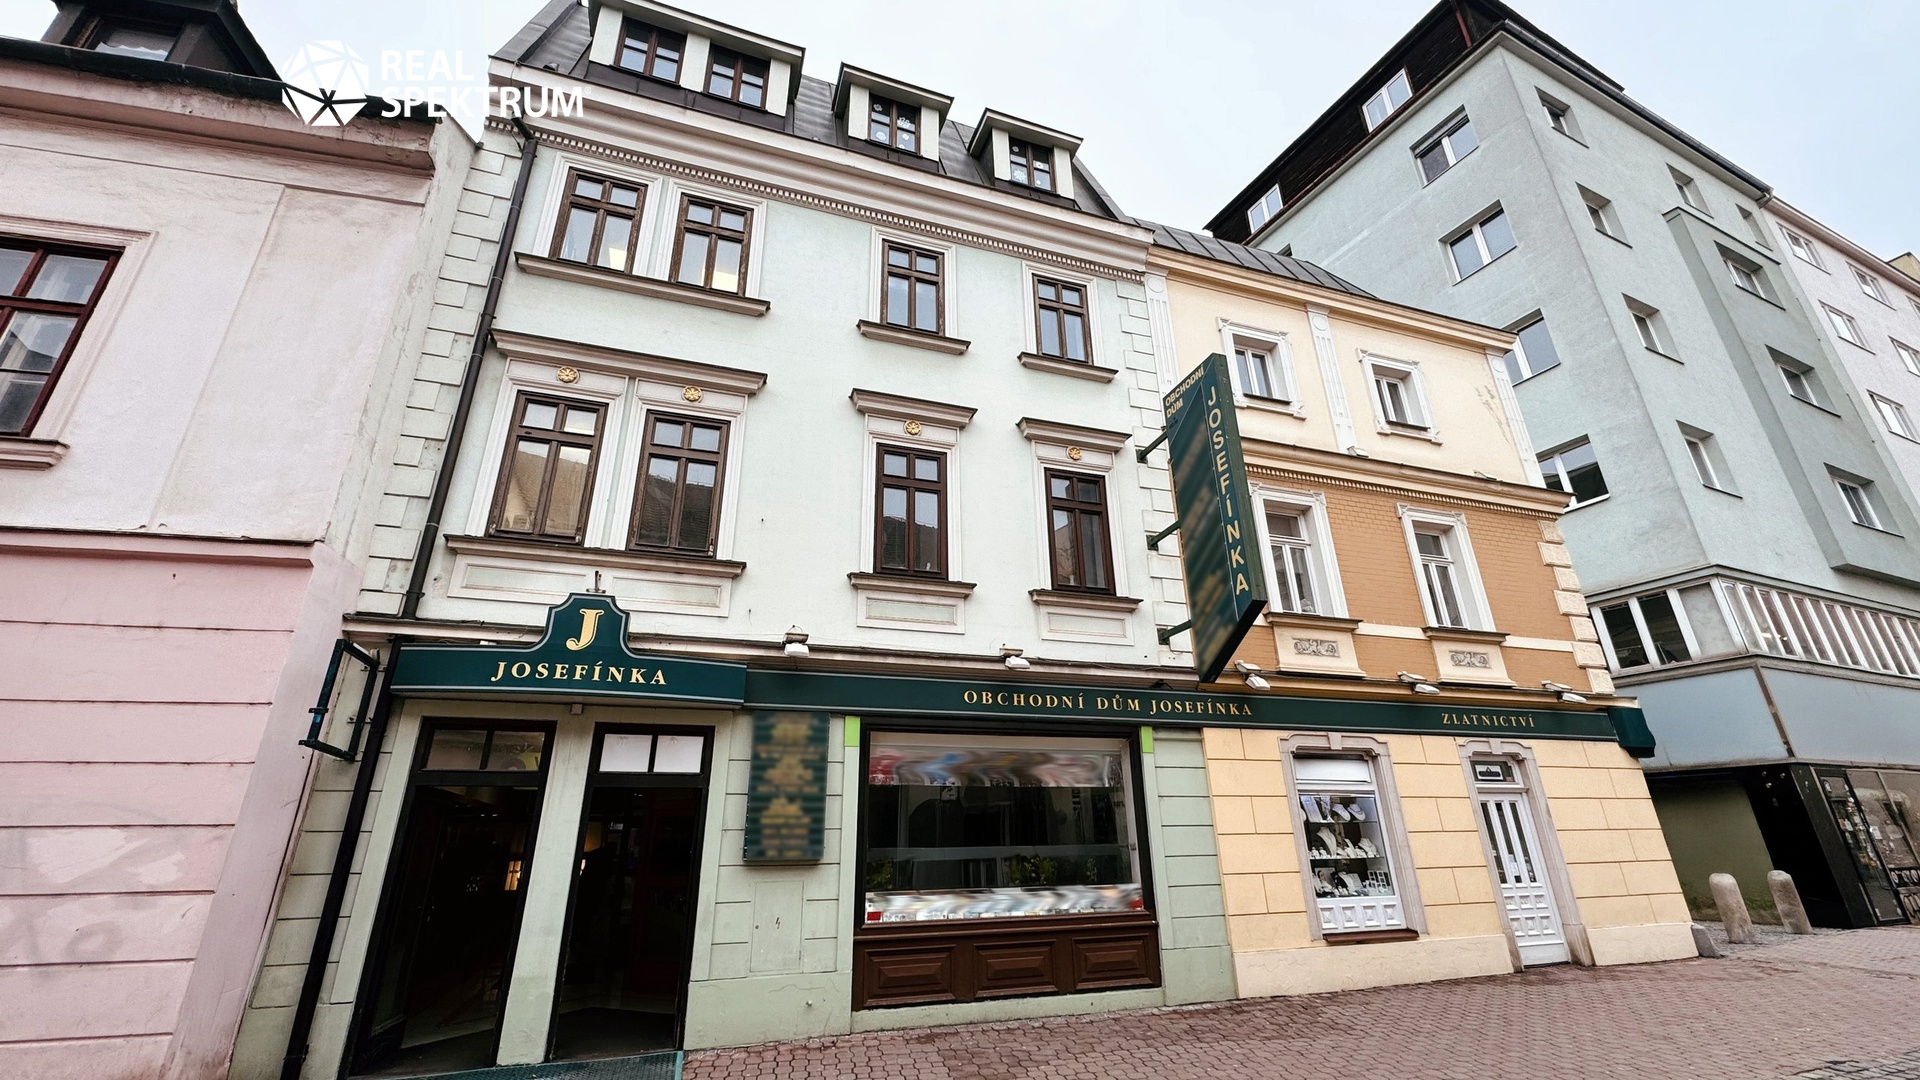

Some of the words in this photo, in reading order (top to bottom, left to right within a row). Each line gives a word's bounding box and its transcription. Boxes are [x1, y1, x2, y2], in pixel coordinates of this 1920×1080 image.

[1165, 364, 1204, 406] OBCHODNÍ
[1207, 385, 1249, 596] JOSEFÍNKA
[565, 608, 604, 651] J
[490, 661, 667, 685] JOSEFÍNKA
[963, 690, 1085, 710] OBCHODNÍ
[1096, 694, 1141, 711] DŮM
[1149, 698, 1252, 716] JOSEFÍNKA
[1441, 713, 1535, 728] ZLATNICTVÍ
